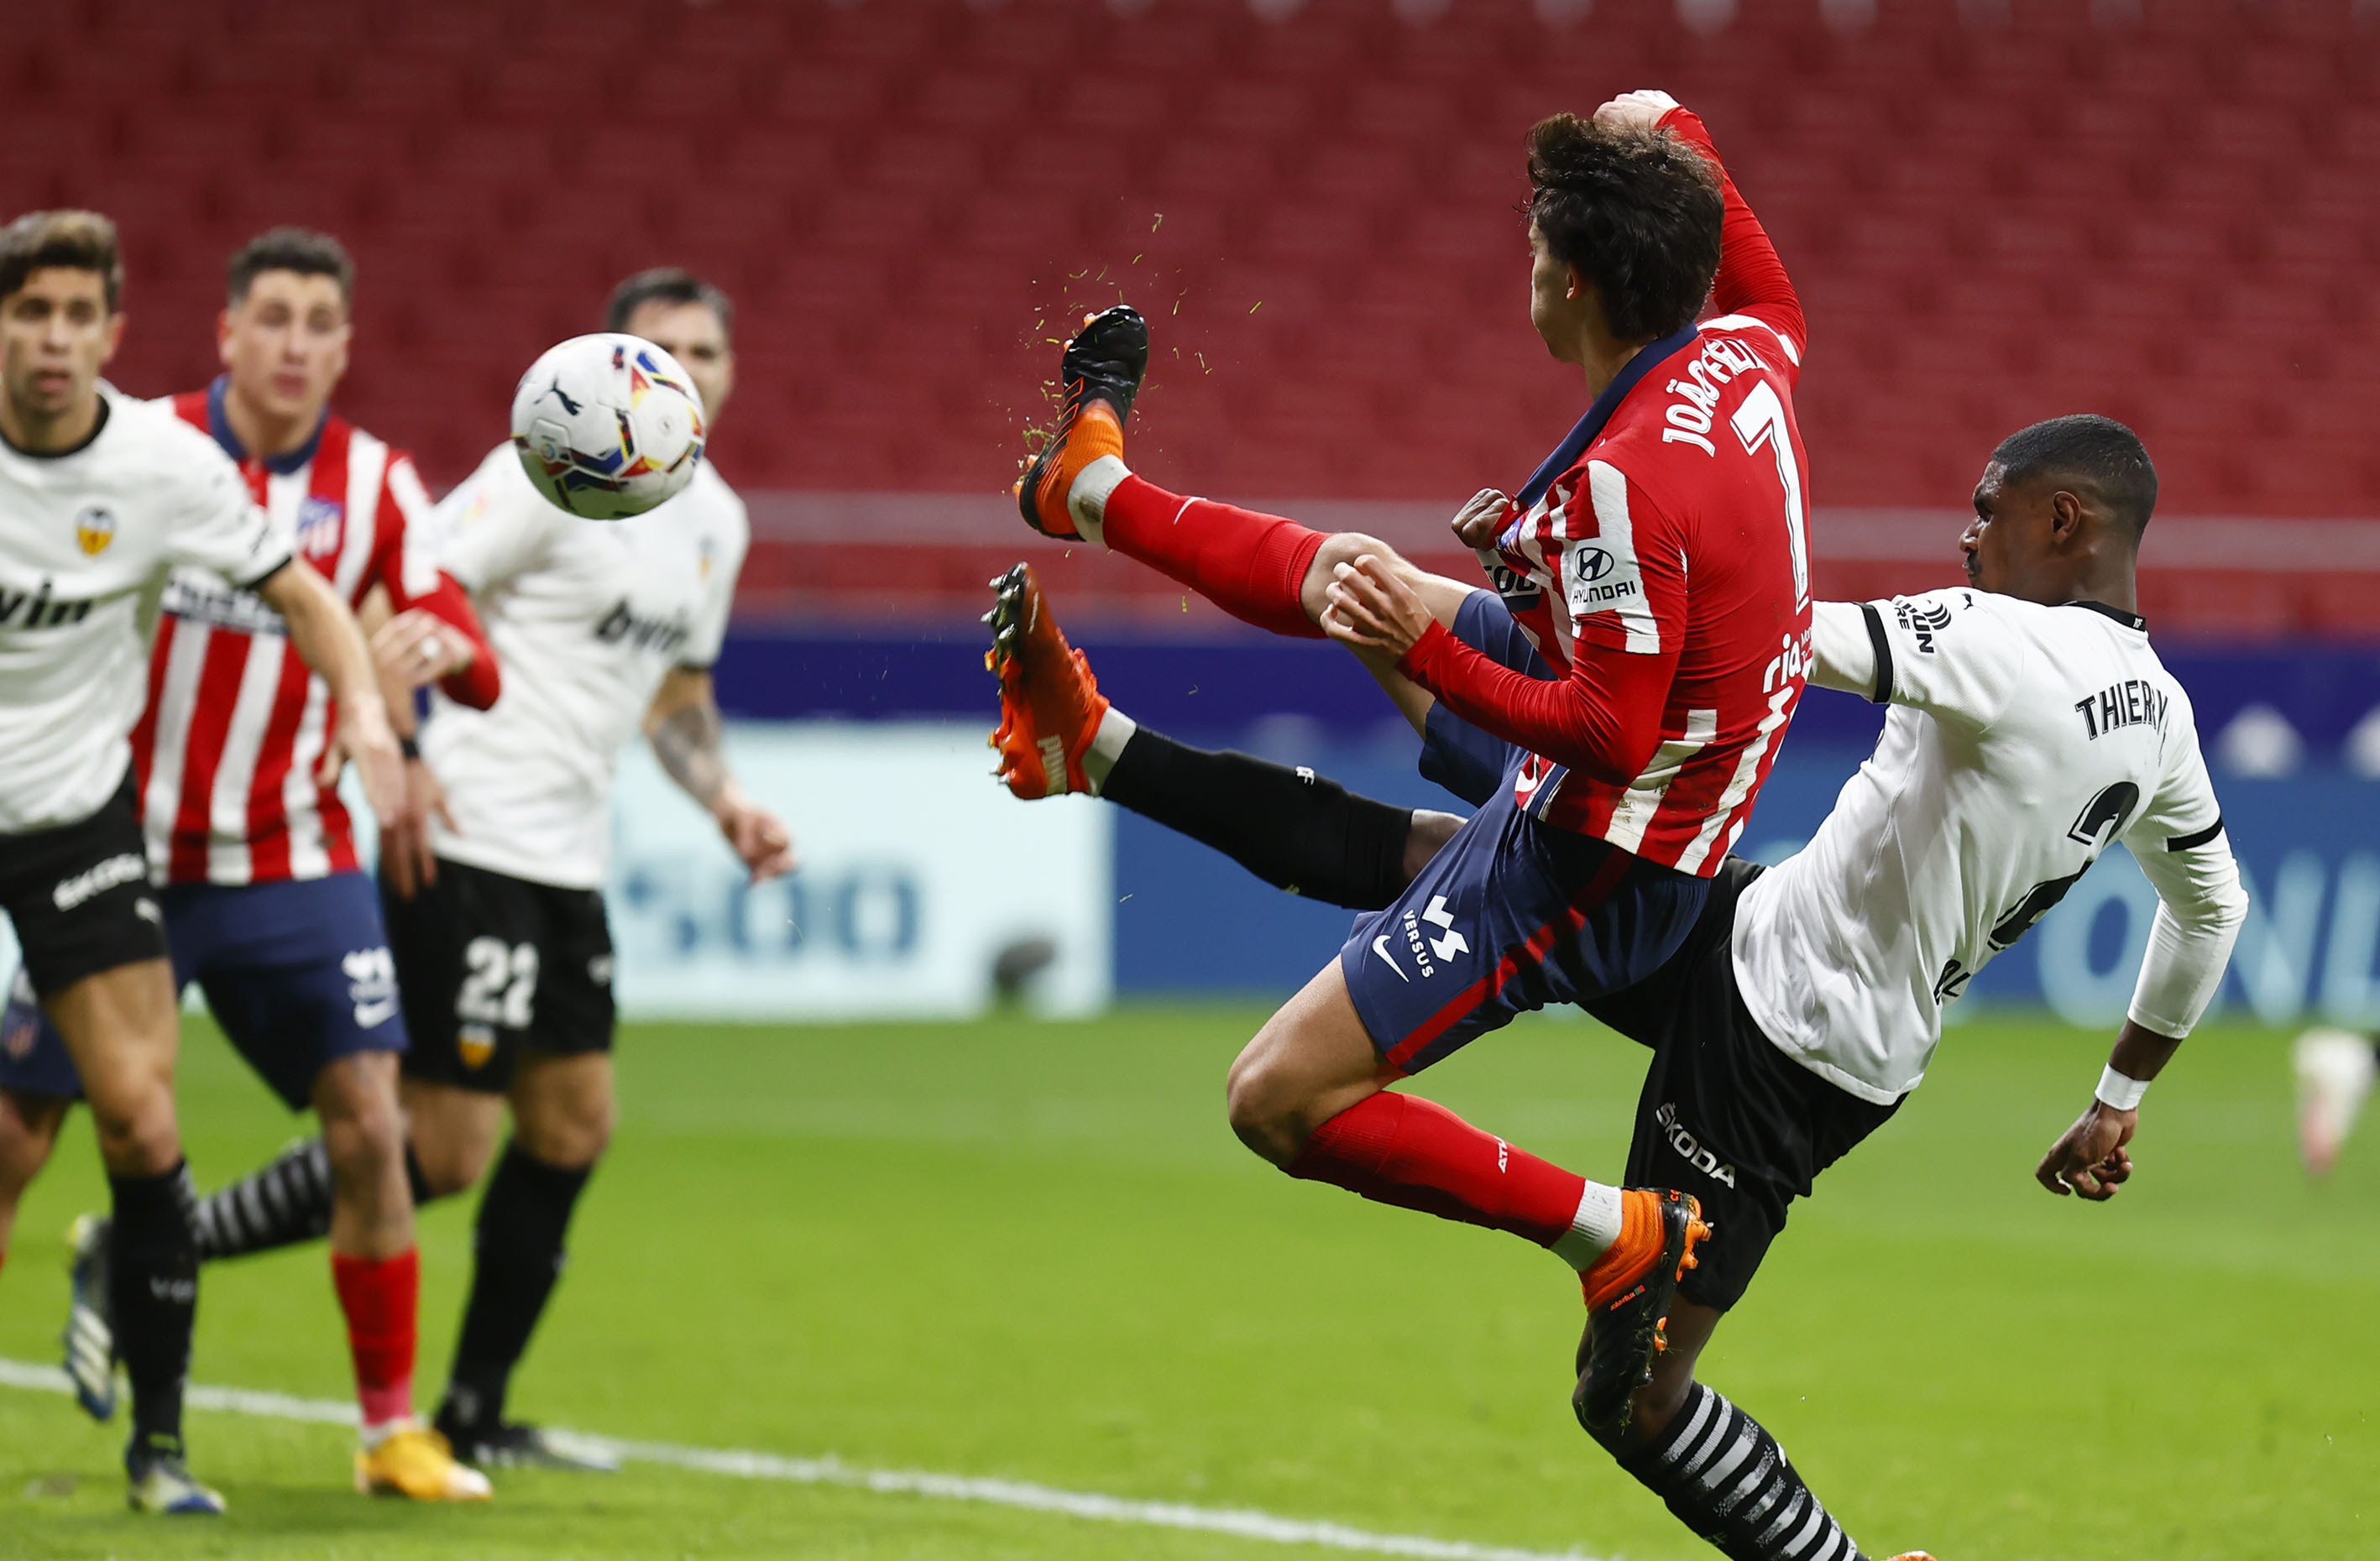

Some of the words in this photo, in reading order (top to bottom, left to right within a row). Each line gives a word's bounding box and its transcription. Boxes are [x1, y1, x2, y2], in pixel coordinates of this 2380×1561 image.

[1729, 379, 1810, 615] 7
[1572, 581, 1636, 605] HYUNDAI
[2074, 679, 2168, 741] THIERY
[1403, 909, 1435, 979] VERSUS
[1656, 1101, 1736, 1190] ŠKODA
